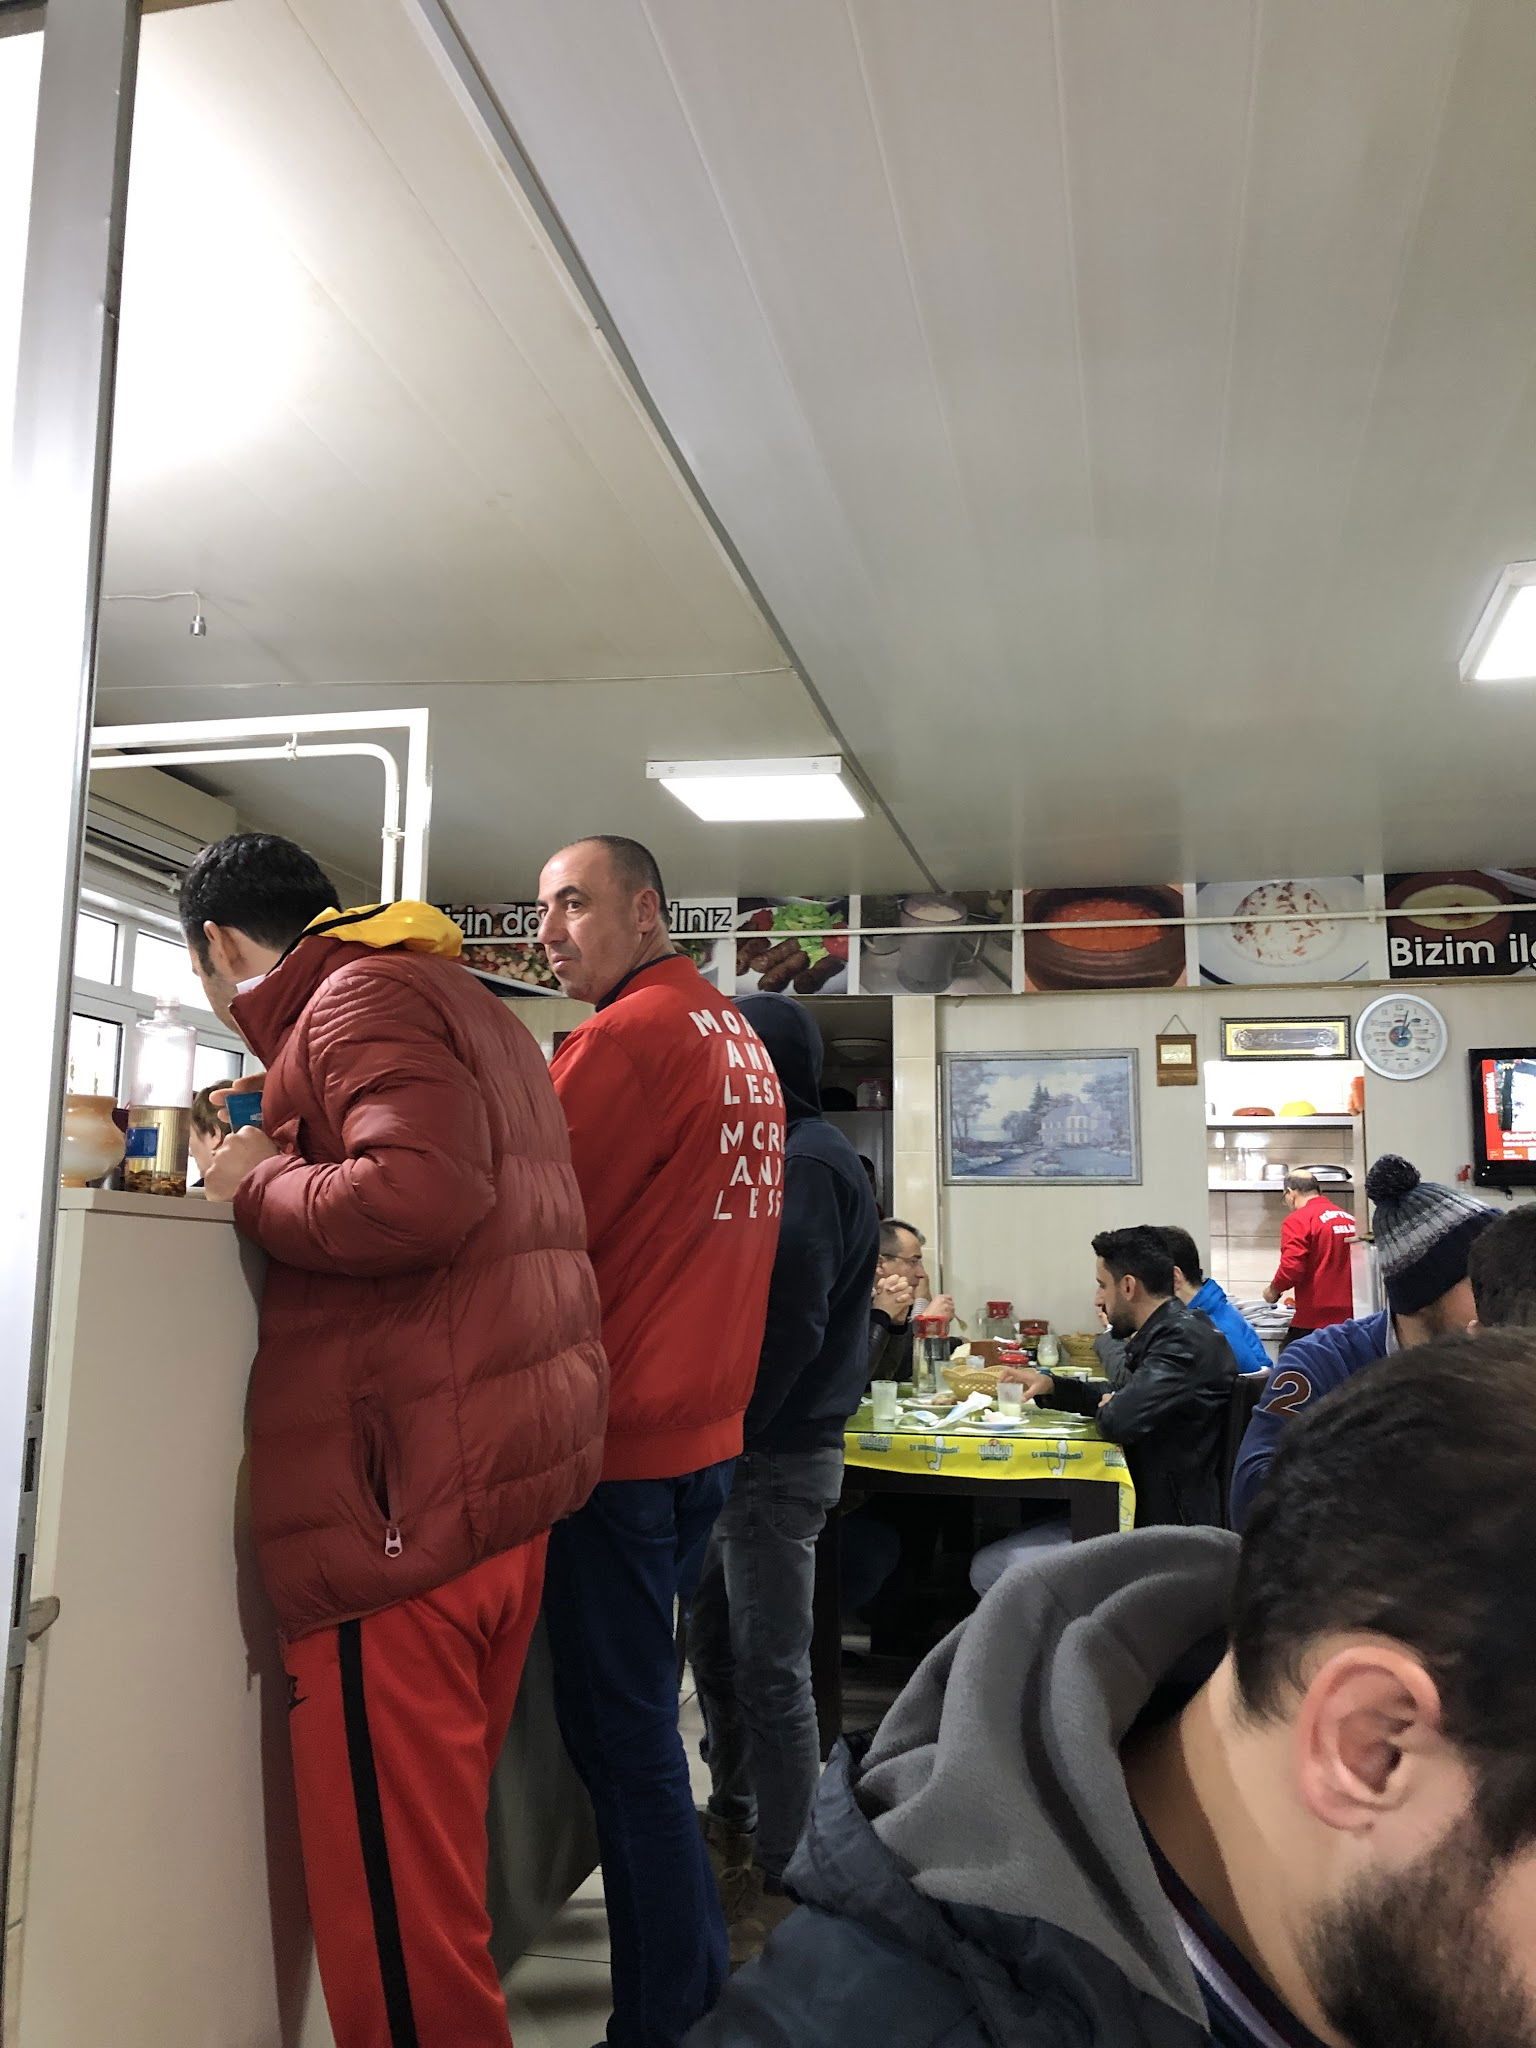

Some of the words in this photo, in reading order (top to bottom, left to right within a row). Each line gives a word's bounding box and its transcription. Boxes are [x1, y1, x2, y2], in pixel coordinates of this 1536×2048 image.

[1389, 935, 1496, 967] Bizim
[1508, 932, 1536, 971] il
[1263, 1370, 1312, 1420] 2
